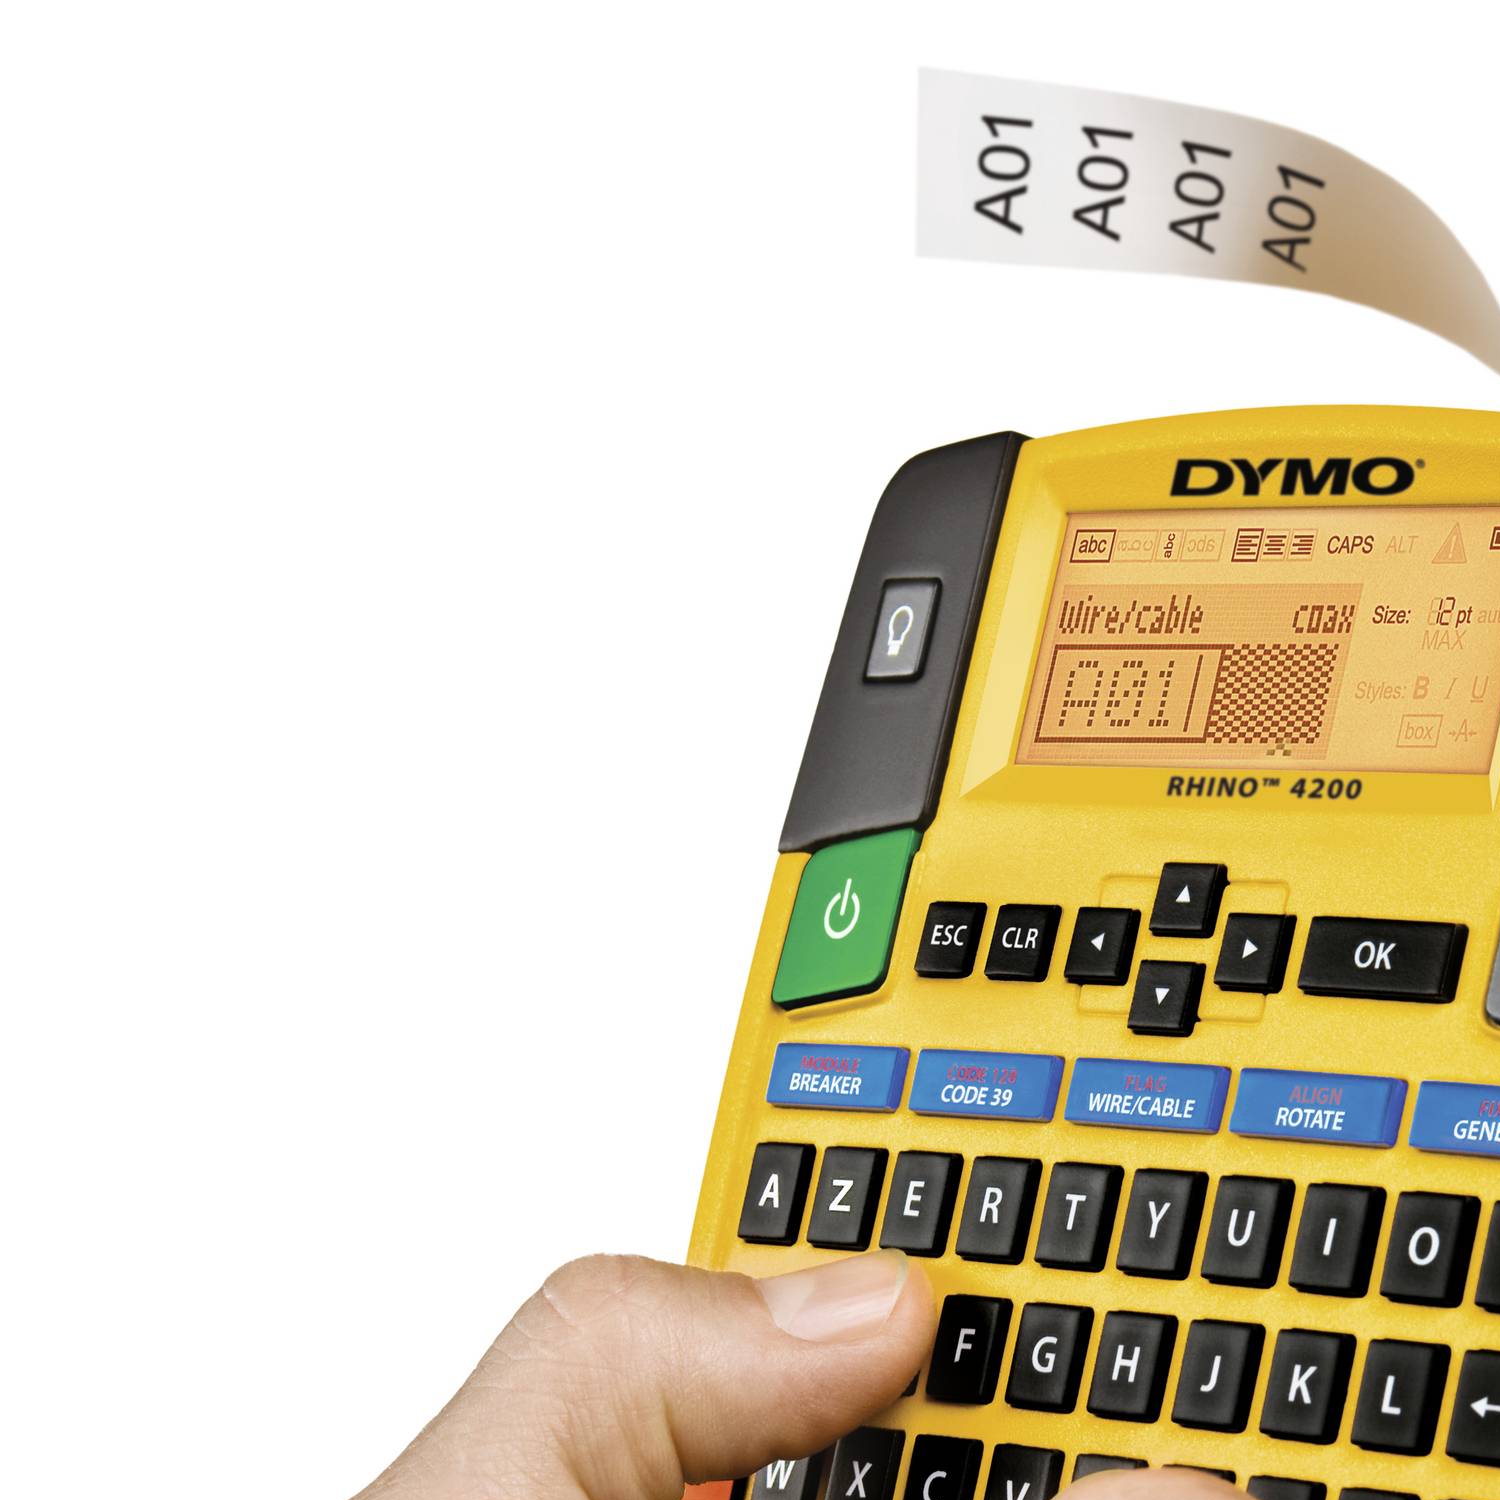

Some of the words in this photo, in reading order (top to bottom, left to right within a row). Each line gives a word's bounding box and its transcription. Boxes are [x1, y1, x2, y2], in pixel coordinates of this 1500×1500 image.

[973, 115, 1034, 235] A01
[1072, 126, 1134, 243] A01
[1168, 141, 1232, 255] A01
[1261, 164, 1325, 273] A01
[1170, 457, 1415, 496] DYMO
[1078, 535, 1107, 554] abc
[1163, 533, 1176, 559] abc
[1327, 535, 1374, 555] CAPS
[1385, 536, 1418, 554] ALT
[1292, 605, 1355, 634] coax
[1372, 605, 1411, 625] Size:
[1435, 597, 1456, 626] 12
[1455, 606, 1472, 628] pt
[1421, 630, 1467, 650] MAX
[1059, 661, 1174, 727] A01
[1354, 681, 1407, 704] Styles:
[1412, 676, 1430, 700] B
[1470, 676, 1489, 703] U
[1404, 721, 1434, 740] box
[1290, 778, 1362, 800] 4200
[930, 924, 968, 947] ESC
[1001, 926, 1039, 949] CLR
[1354, 941, 1397, 971] OK
[789, 1072, 861, 1096] BREAKER
[940, 1084, 988, 1106] CODE
[990, 1088, 1013, 1108] 39
[1124, 1075, 1168, 1092] FLAG
[1288, 1085, 1343, 1105] ALIGN
[1088, 1092, 1196, 1119] WIRE/CABLE
[1275, 1107, 1345, 1131] ROTATE
[758, 1173, 780, 1208] A
[828, 1179, 854, 1212] Z
[903, 1181, 925, 1217] E
[979, 1187, 1003, 1224] R
[1065, 1194, 1087, 1231] T
[1147, 1201, 1171, 1239] Y
[1227, 1210, 1255, 1247] U
[1322, 1218, 1337, 1256] I
[1408, 1226, 1440, 1266] O
[954, 1328, 975, 1363] F
[1031, 1336, 1058, 1374] G
[1111, 1345, 1140, 1383] H
[1200, 1355, 1222, 1393] J
[1288, 1365, 1318, 1404] K
[1381, 1375, 1401, 1415] L
[765, 1459, 796, 1490] W
[846, 1461, 873, 1499] X
